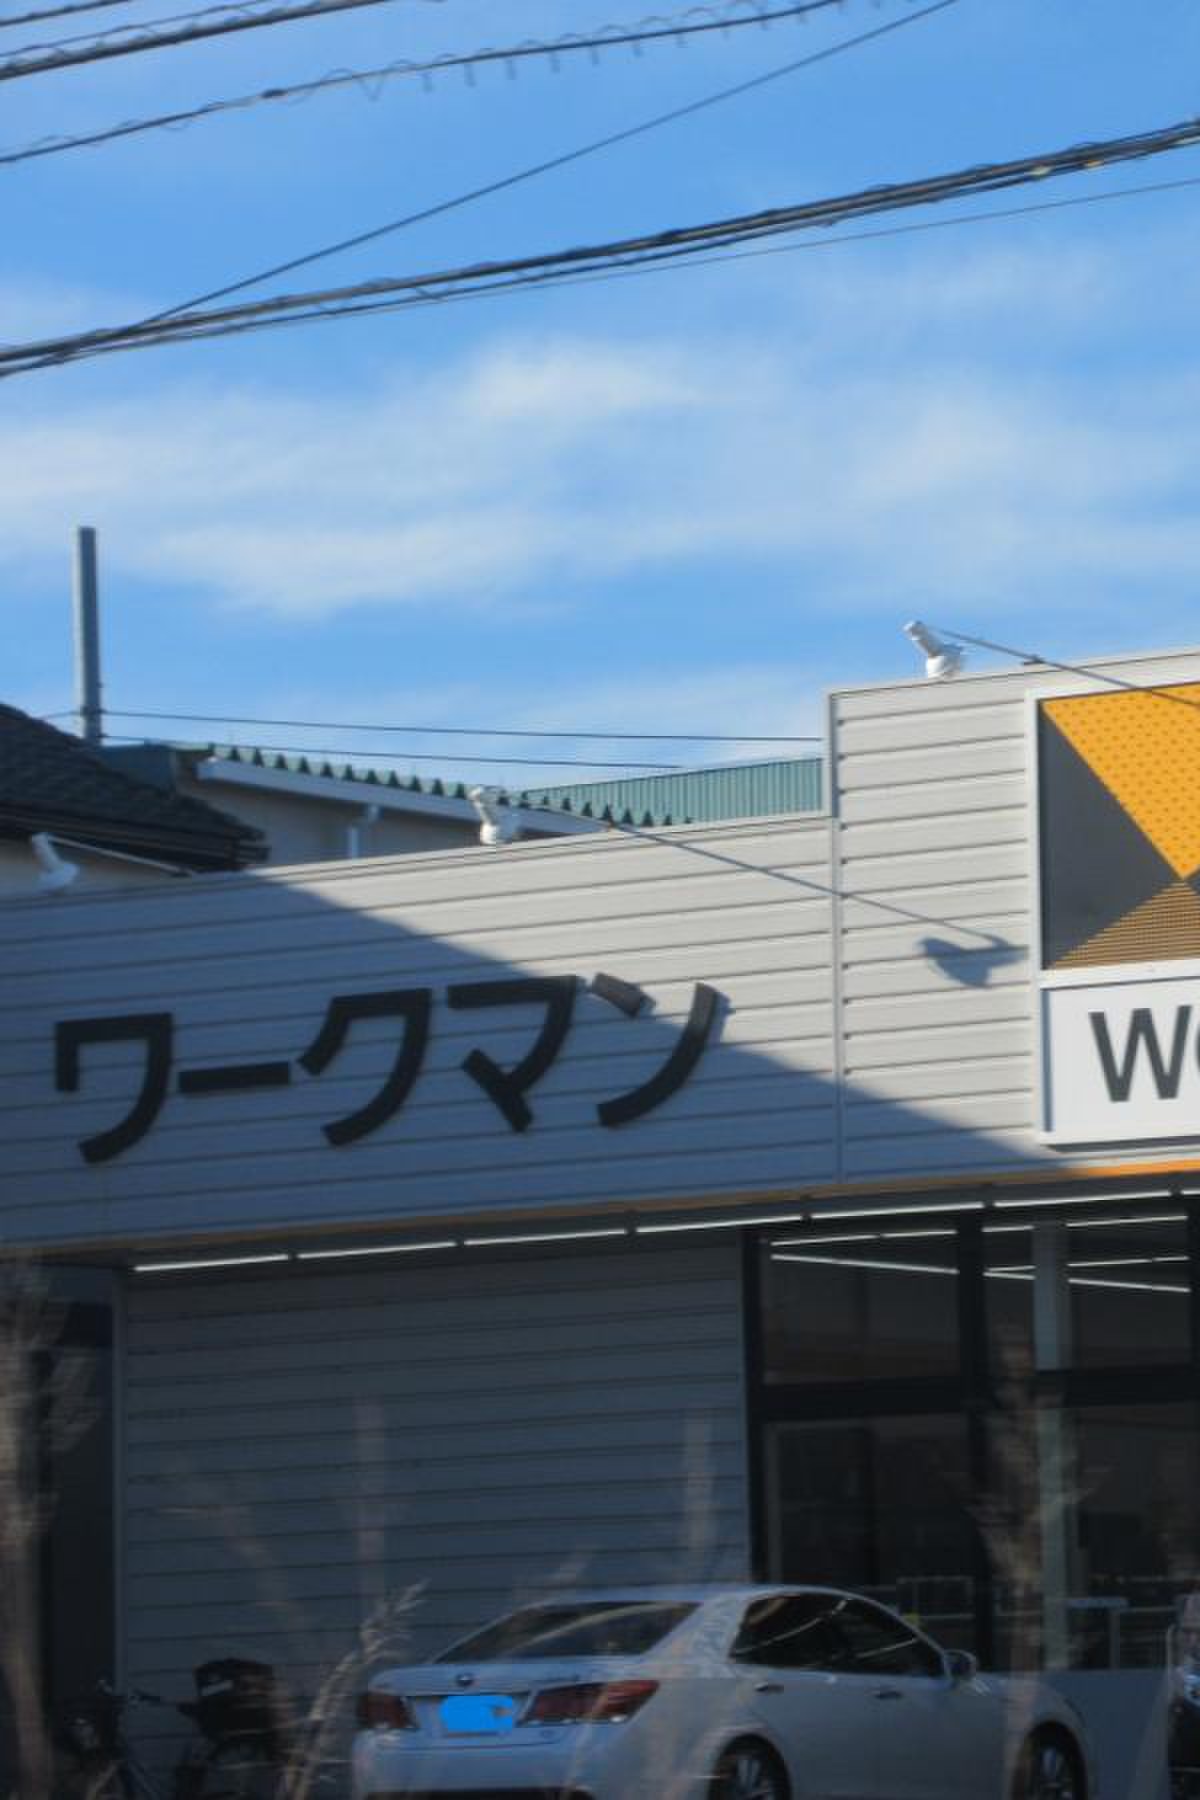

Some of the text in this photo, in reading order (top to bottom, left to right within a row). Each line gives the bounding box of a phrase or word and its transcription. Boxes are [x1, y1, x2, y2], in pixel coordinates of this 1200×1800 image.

[54, 972, 720, 1164] ワークマン
